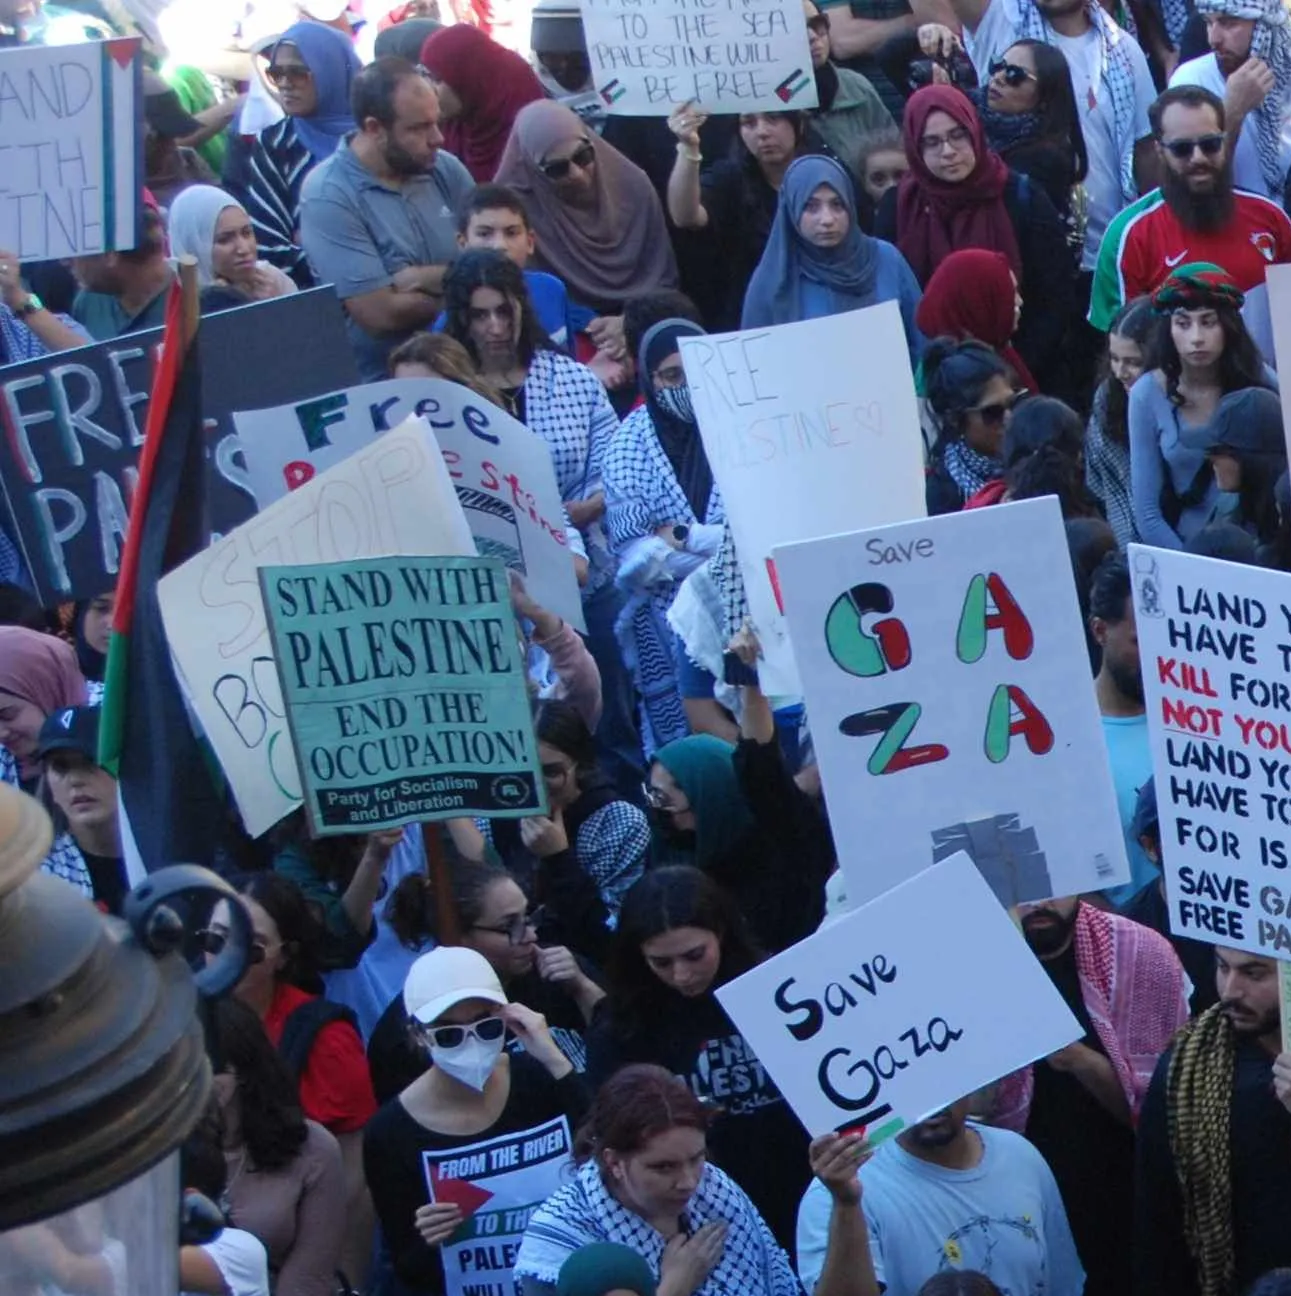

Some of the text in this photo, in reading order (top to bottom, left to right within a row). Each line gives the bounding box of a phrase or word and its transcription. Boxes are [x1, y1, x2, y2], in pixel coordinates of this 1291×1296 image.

[617, 10, 790, 43] TO THE SEA
[593, 41, 780, 69] PALESTINE WILL
[643, 69, 770, 104] BE FREE
[0, 138, 87, 187] TH
[0, 186, 101, 257] INE
[681, 333, 778, 414] REE
[2, 342, 166, 483] FRE
[295, 394, 500, 452] Free
[866, 537, 934, 566] Save
[277, 566, 500, 617] STAND WITH
[1177, 585, 1267, 628] LAND
[286, 618, 512, 689] PALESTINE
[1168, 618, 1258, 665] HAVE
[1157, 656, 1218, 697] KILL
[1230, 673, 1291, 712] FOR
[336, 692, 488, 738] END THE
[1162, 697, 1223, 736] NOT
[311, 729, 529, 781] OCCUPATION!
[1167, 738, 1251, 780] LAND
[327, 776, 479, 807] Party for Socialism
[349, 794, 464, 823] and Liberation
[1170, 776, 1249, 817] HAVE
[1177, 818, 1288, 869] FOR IS
[1178, 867, 1250, 908] SAVE
[1179, 900, 1244, 939] FREE
[775, 955, 896, 1041] Save
[818, 1017, 963, 1111] Gaza
[438, 1129, 564, 1181] FROM THE RIVER
[475, 1207, 535, 1235] TO TH
